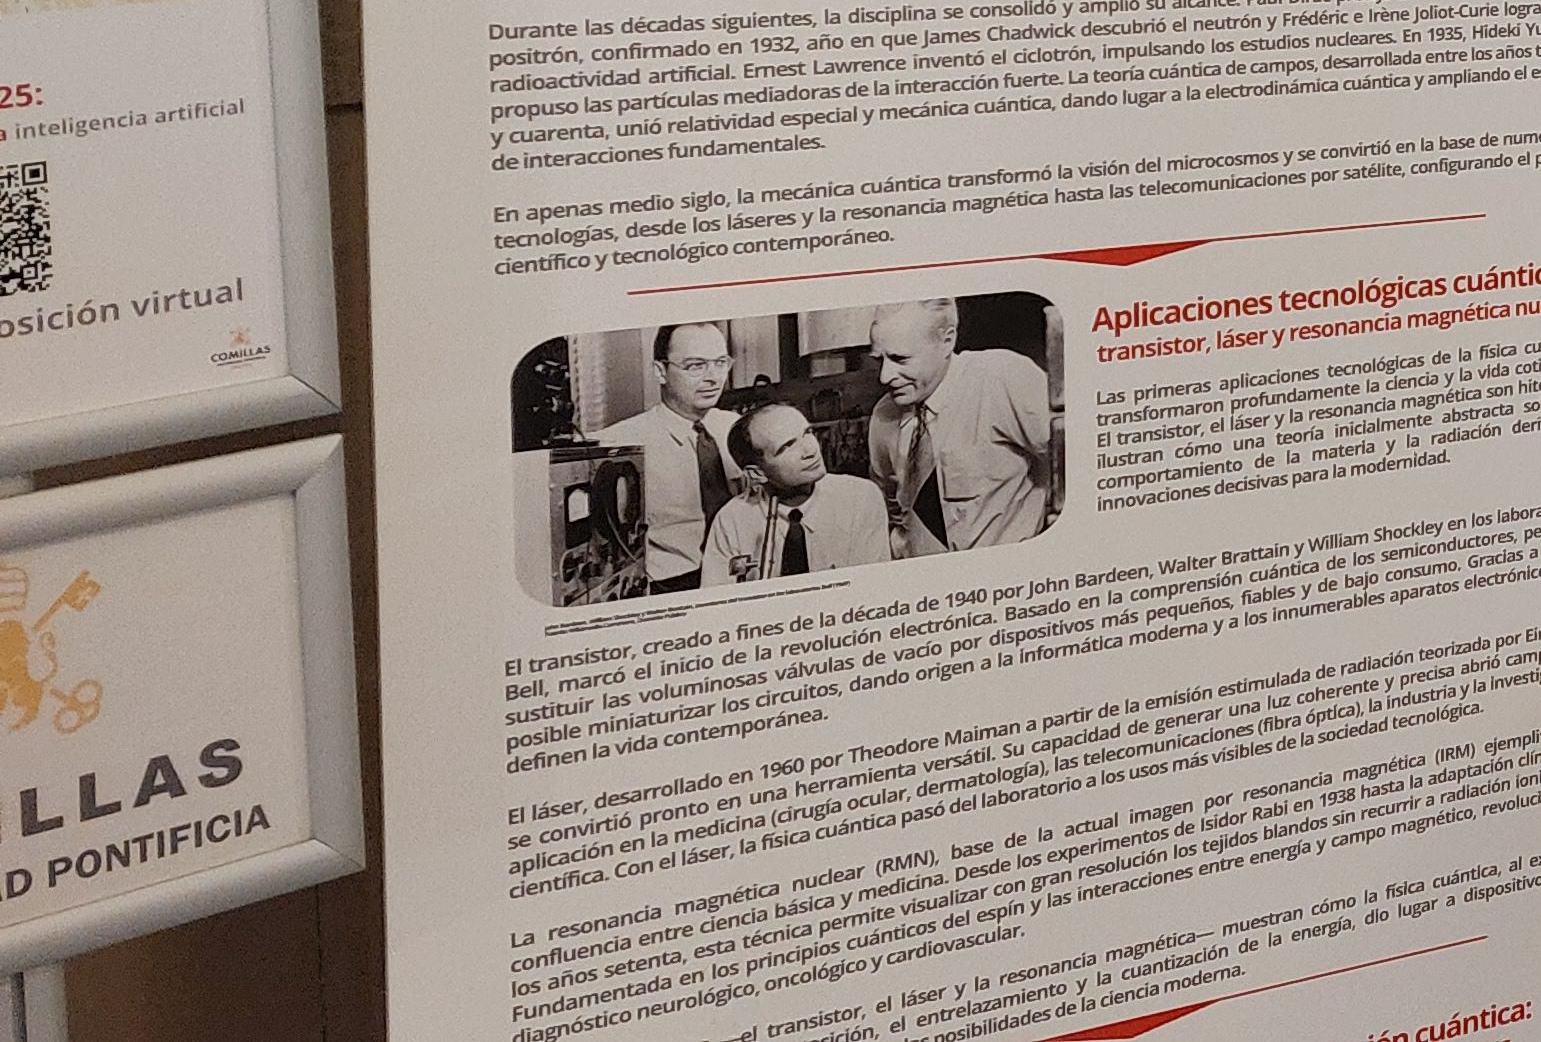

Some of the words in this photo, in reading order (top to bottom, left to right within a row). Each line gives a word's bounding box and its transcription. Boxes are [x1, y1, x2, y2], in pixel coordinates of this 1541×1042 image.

[15, 110, 147, 140] inteligencia
[154, 98, 244, 124] artificial
[491, 153, 520, 171] de
[523, 146, 664, 169] interacciones
[667, 134, 826, 160] fundamentales.
[494, 252, 591, 276] científico
[594, 253, 609, 272] y
[611, 240, 729, 266] tecnológico
[732, 228, 895, 255] contemporáneo.
[0, 299, 120, 338] osición
[131, 277, 243, 318] virtual
[1091, 295, 1273, 338] Aplicaciones
[1278, 275, 1448, 312] tecnológicas
[1096, 336, 1211, 363] transistor,
[1216, 328, 1269, 350] láser
[1271, 327, 1286, 349] y
[1289, 312, 1402, 342] resonancia
[1407, 304, 1511, 330] magnética
[210, 346, 271, 363] COMILLAS
[1096, 390, 1126, 406] Las
[1133, 380, 1212, 406] primeras
[1219, 368, 1320, 395] aplicaciones
[1326, 355, 1425, 378] tecnológicas
[1431, 350, 1452, 366] de
[1458, 347, 1472, 363] la
[1478, 343, 1517, 361] física
[1097, 484, 1211, 512] innovaciones
[1213, 473, 1289, 495] decisivas
[1291, 468, 1329, 489] para
[1332, 463, 1347, 479] la
[1350, 448, 1451, 477] modernidad.
[506, 749, 587, 775] definen
[592, 742, 611, 760] la
[614, 734, 658, 755] vida
[663, 708, 829, 747] contemporánea.
[48, 804, 271, 888] PONTIFICIA
[512, 1010, 632, 1042] diagnóstico
[637, 983, 760, 1021] neurológico,
[764, 958, 867, 992] oncológico
[870, 954, 884, 974] y
[886, 925, 1025, 965] cardiovascular.
[1416, 1001, 1532, 1042] cuántica:
